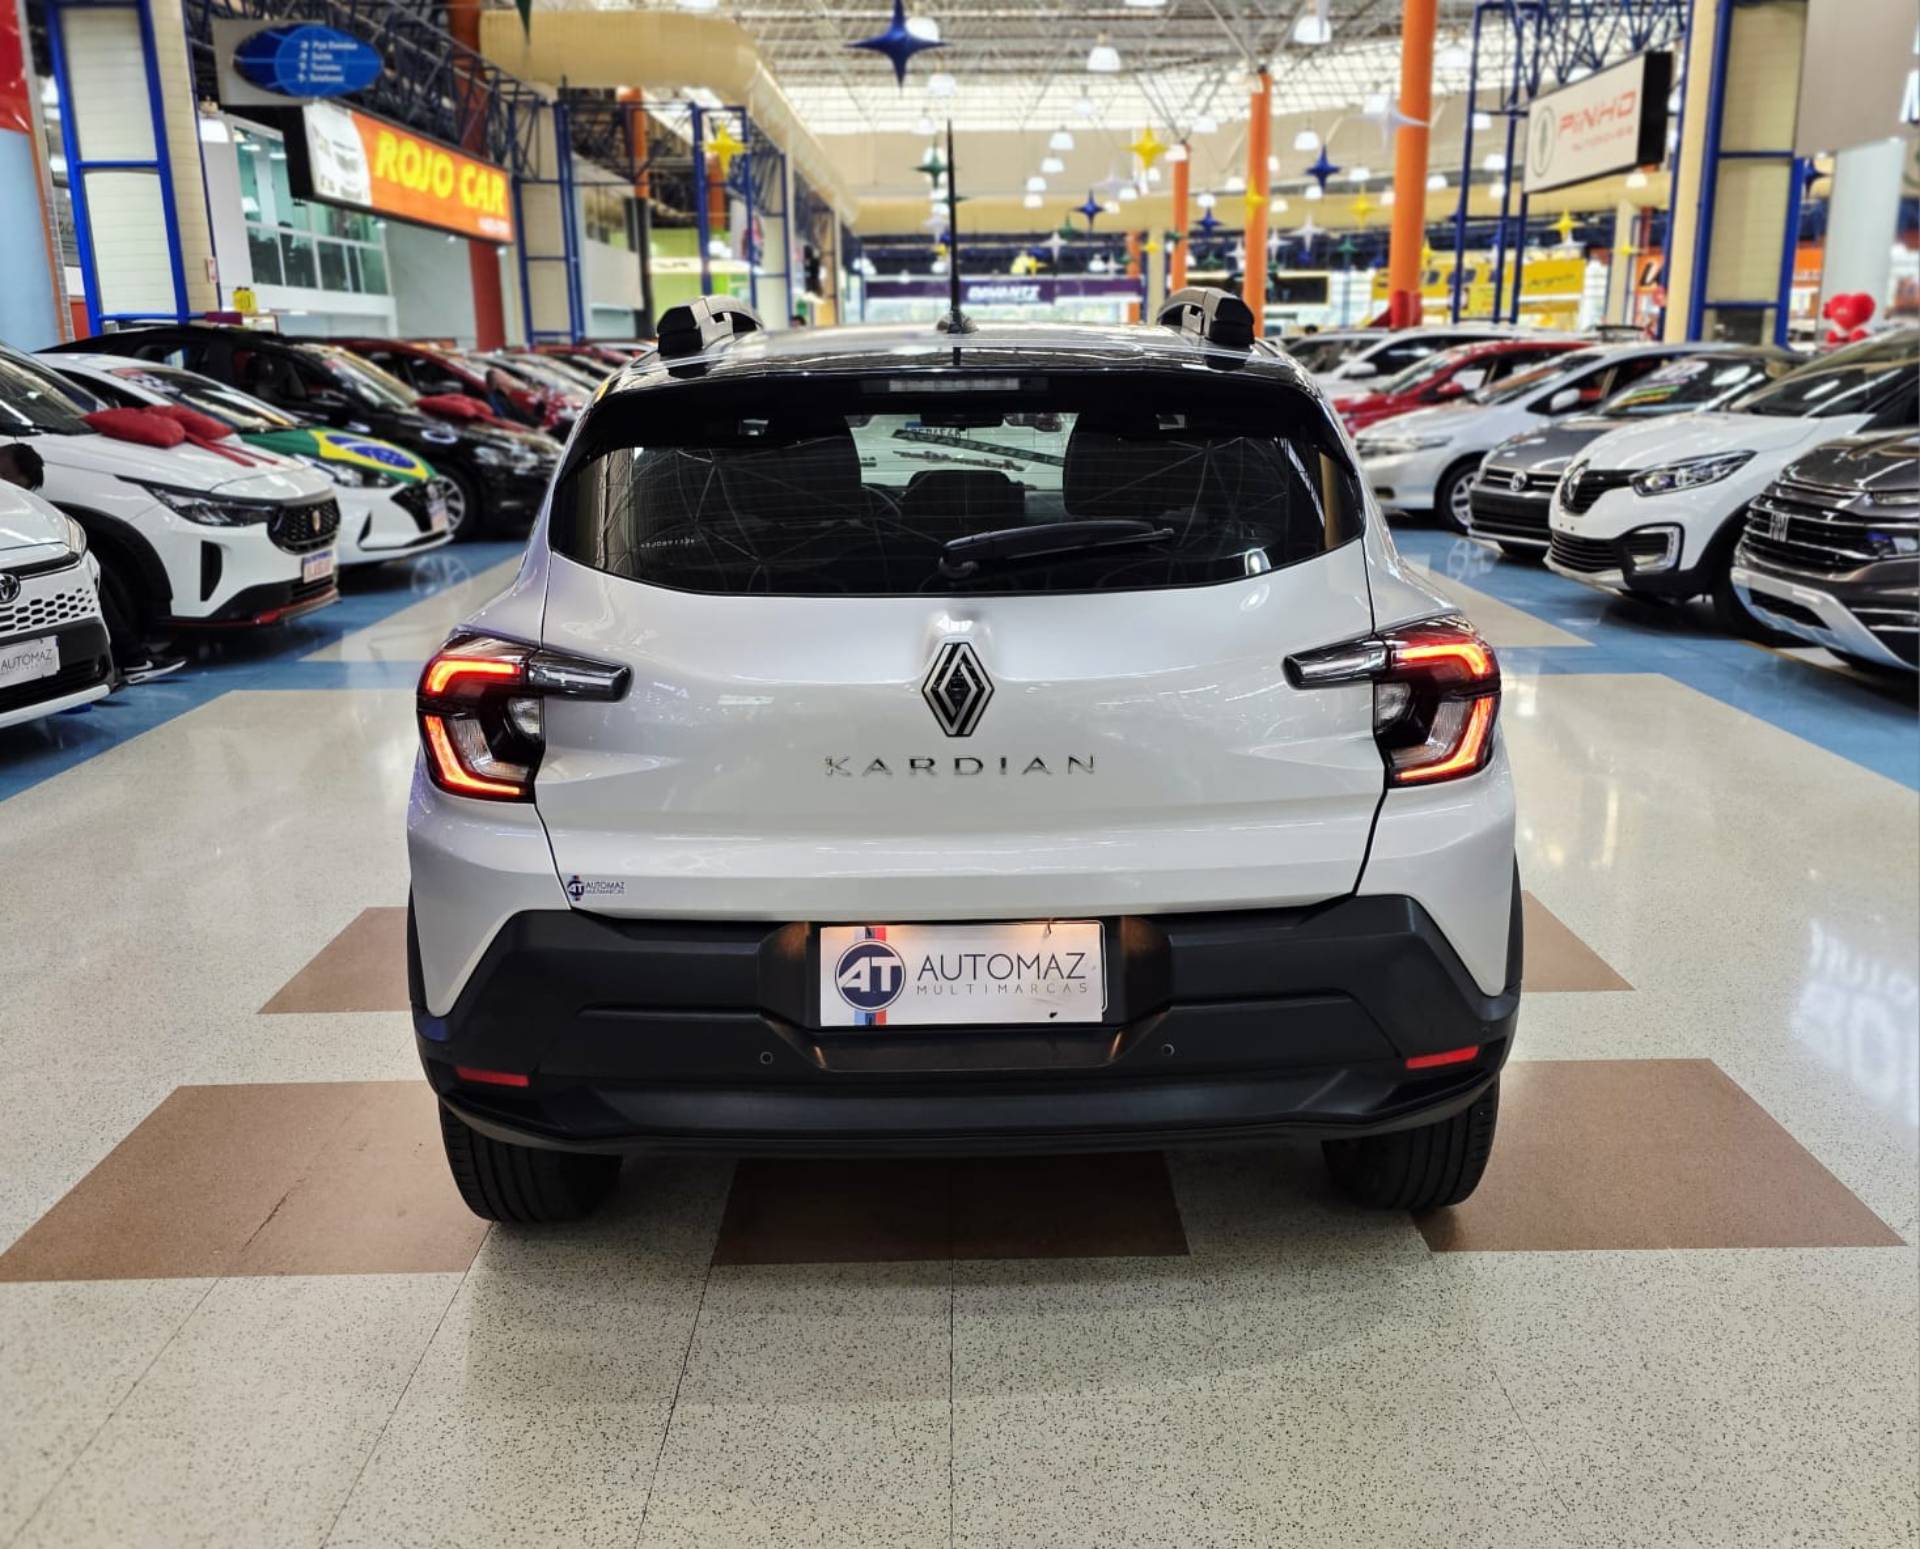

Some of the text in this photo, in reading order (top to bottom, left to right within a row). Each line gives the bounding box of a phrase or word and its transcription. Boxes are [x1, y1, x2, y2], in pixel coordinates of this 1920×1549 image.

[1558, 88, 1637, 137] PINHO
[375, 130, 454, 199] ROJO
[460, 163, 506, 215] CAR
[1, 648, 53, 671] AUTOMAZ
[824, 755, 1096, 777] KARDIAN
[585, 881, 624, 889] AUTOMAZ
[917, 952, 1087, 982] AUTOMAZ
[916, 982, 1088, 996] MULTIMARCAS
